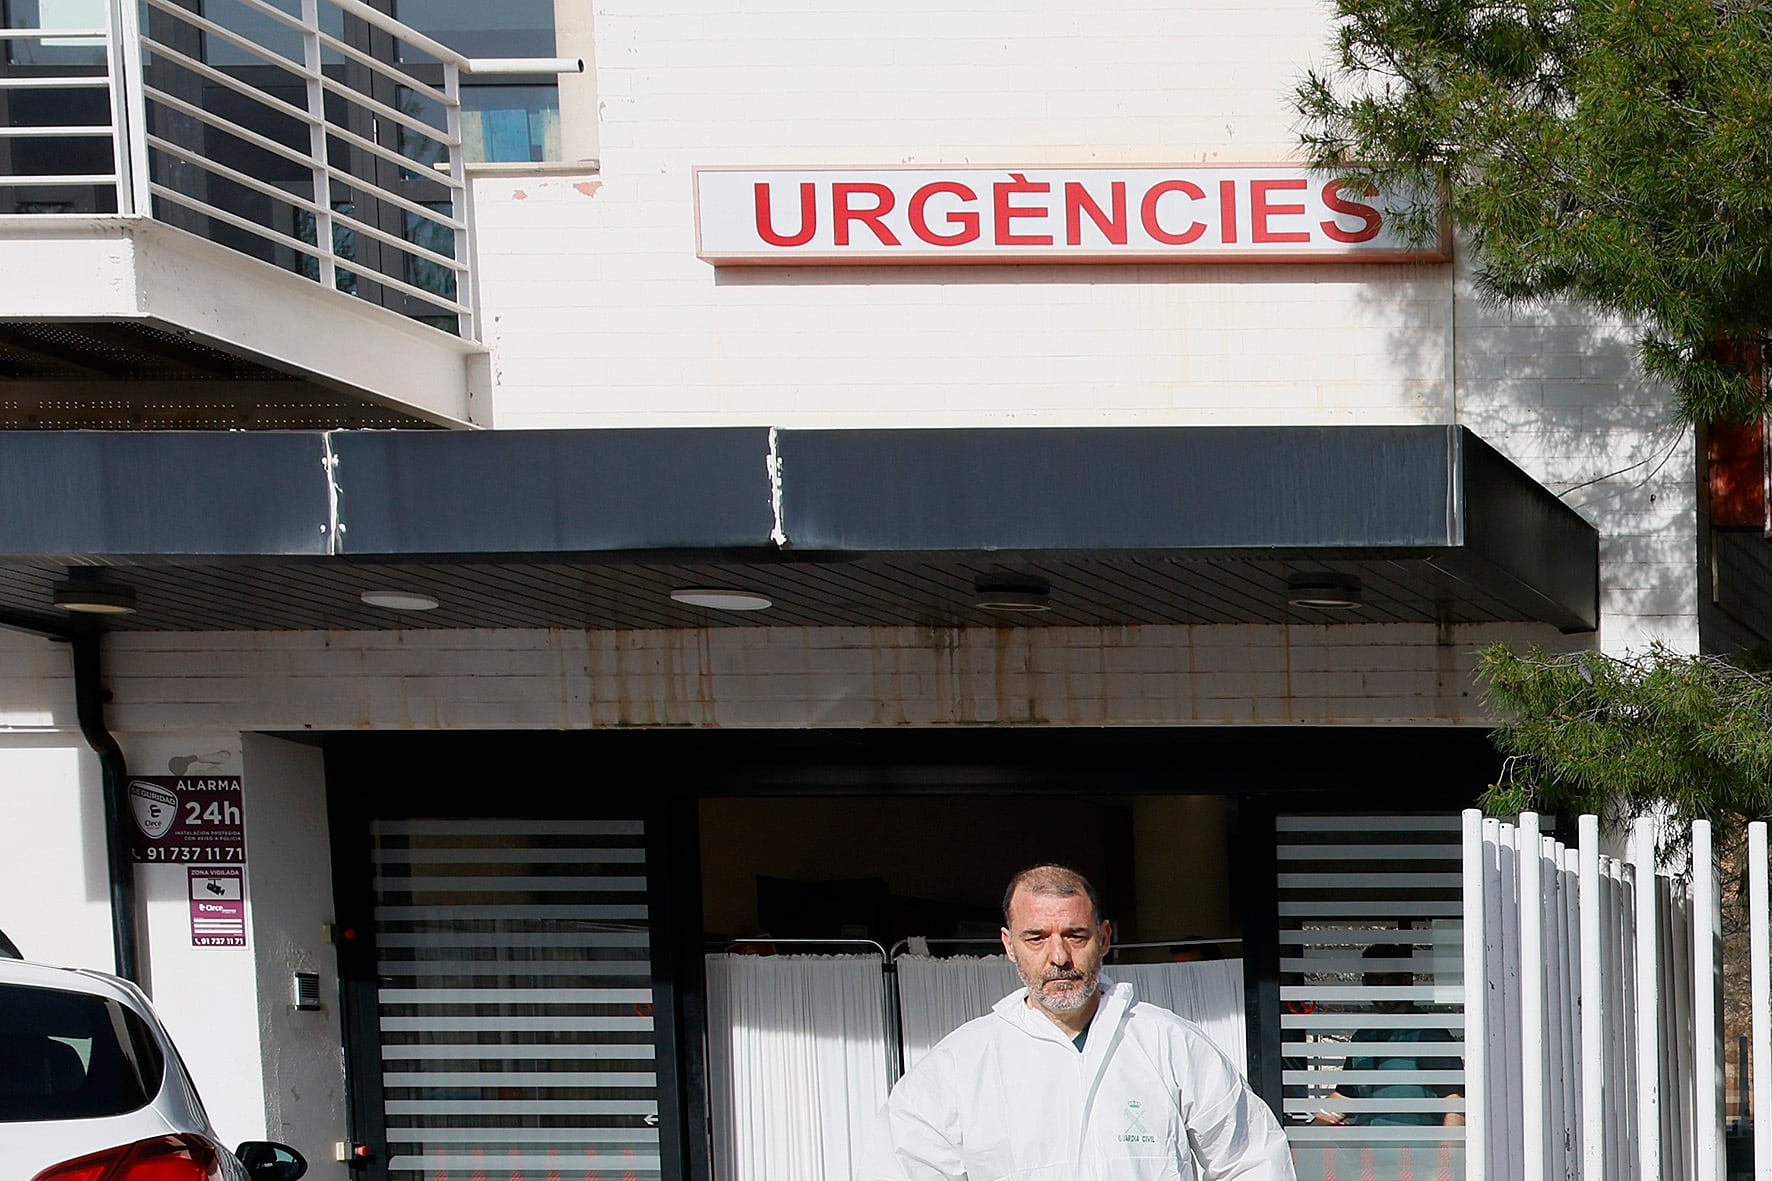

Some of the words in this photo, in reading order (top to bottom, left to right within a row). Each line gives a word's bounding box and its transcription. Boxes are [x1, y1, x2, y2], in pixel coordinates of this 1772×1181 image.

[754, 173, 1382, 247] URGÈNCIES
[176, 780, 240, 791] ALARMA
[131, 787, 176, 805] SEGURIDAD
[185, 801, 241, 825] 24h
[147, 847, 165, 860] 91
[170, 847, 201, 860] 737
[206, 847, 220, 860] 11
[225, 847, 242, 860] 71
[211, 937, 225, 945] 737
[226, 937, 234, 945] 11
[235, 937, 243, 945] 71
